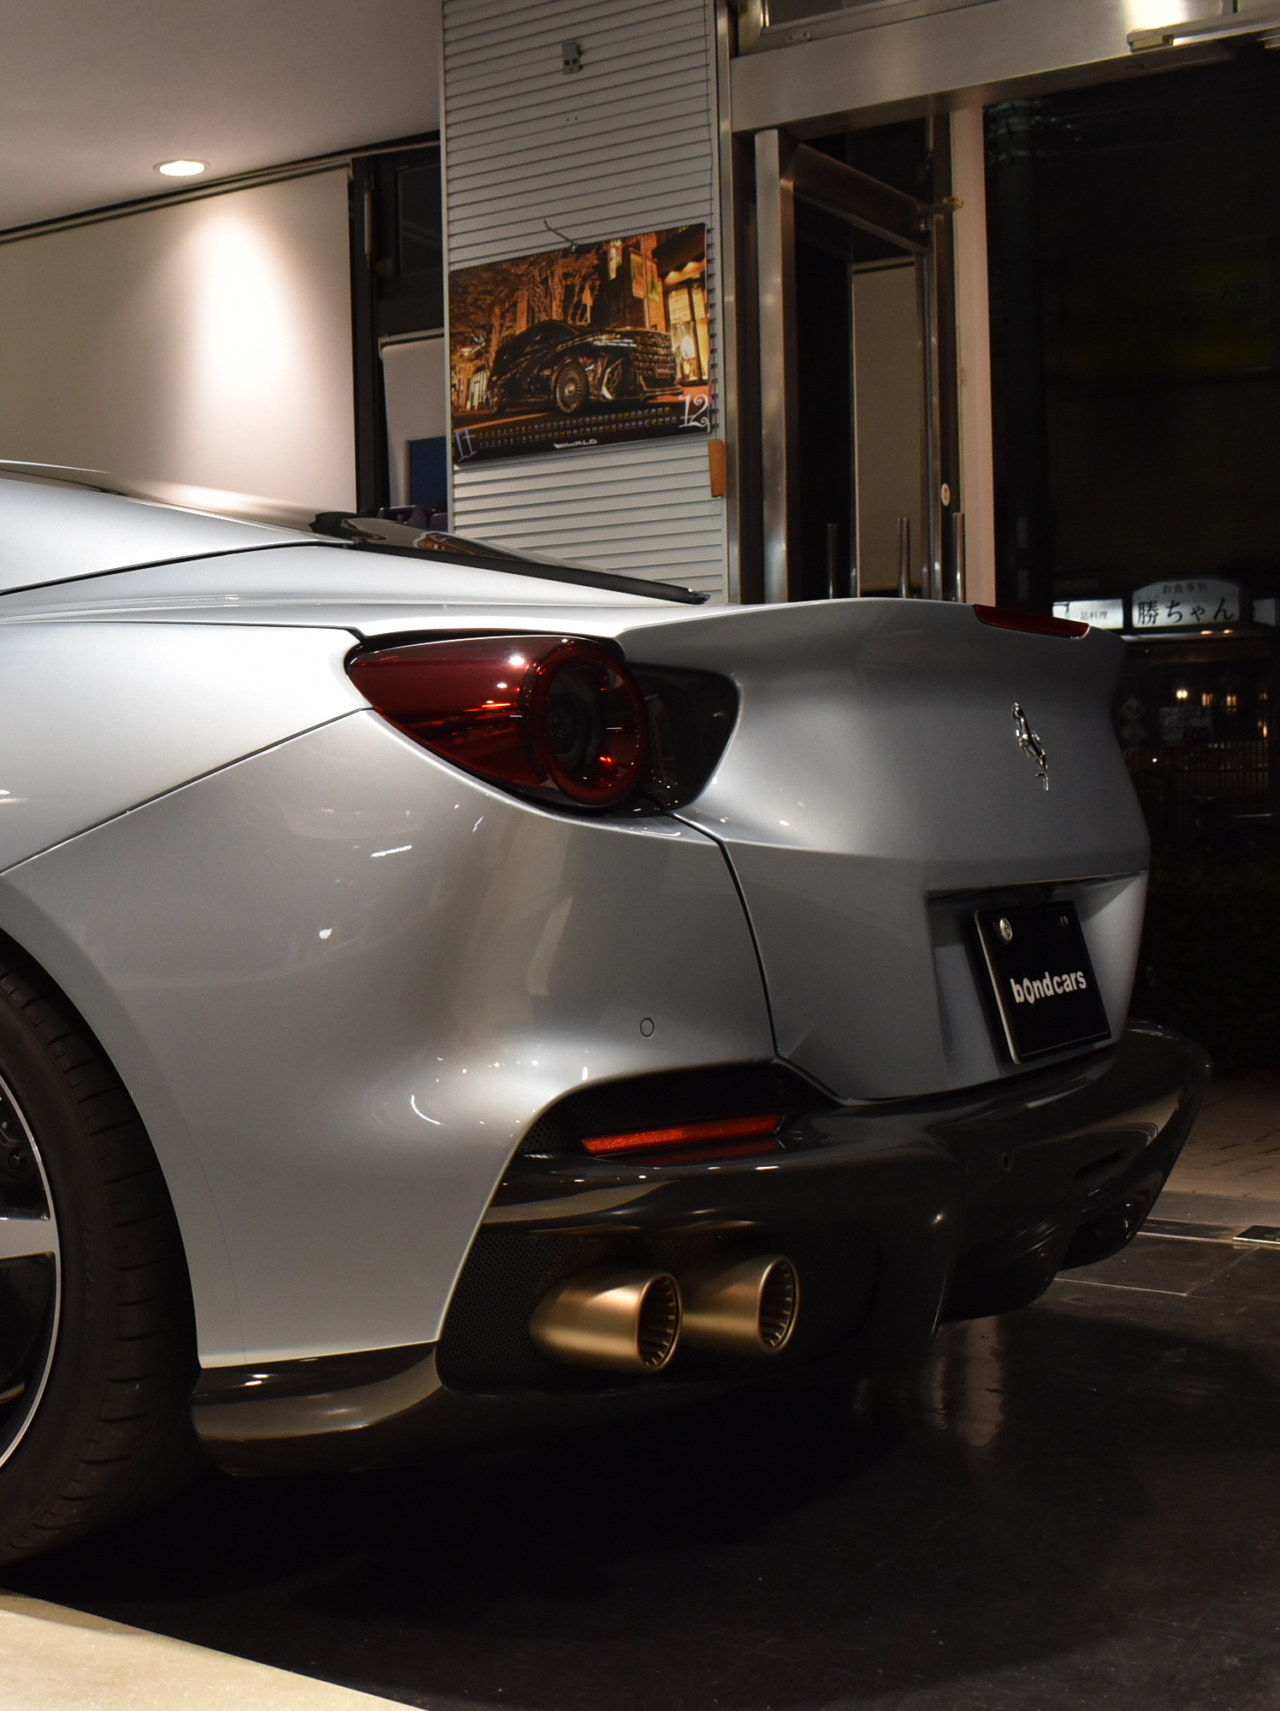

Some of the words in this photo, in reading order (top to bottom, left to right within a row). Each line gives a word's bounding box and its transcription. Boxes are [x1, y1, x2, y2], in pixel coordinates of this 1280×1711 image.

[678, 394, 710, 429] 12
[1137, 598, 1234, 625] 勝ちゃん
[1009, 970, 1087, 1004] bondcars
